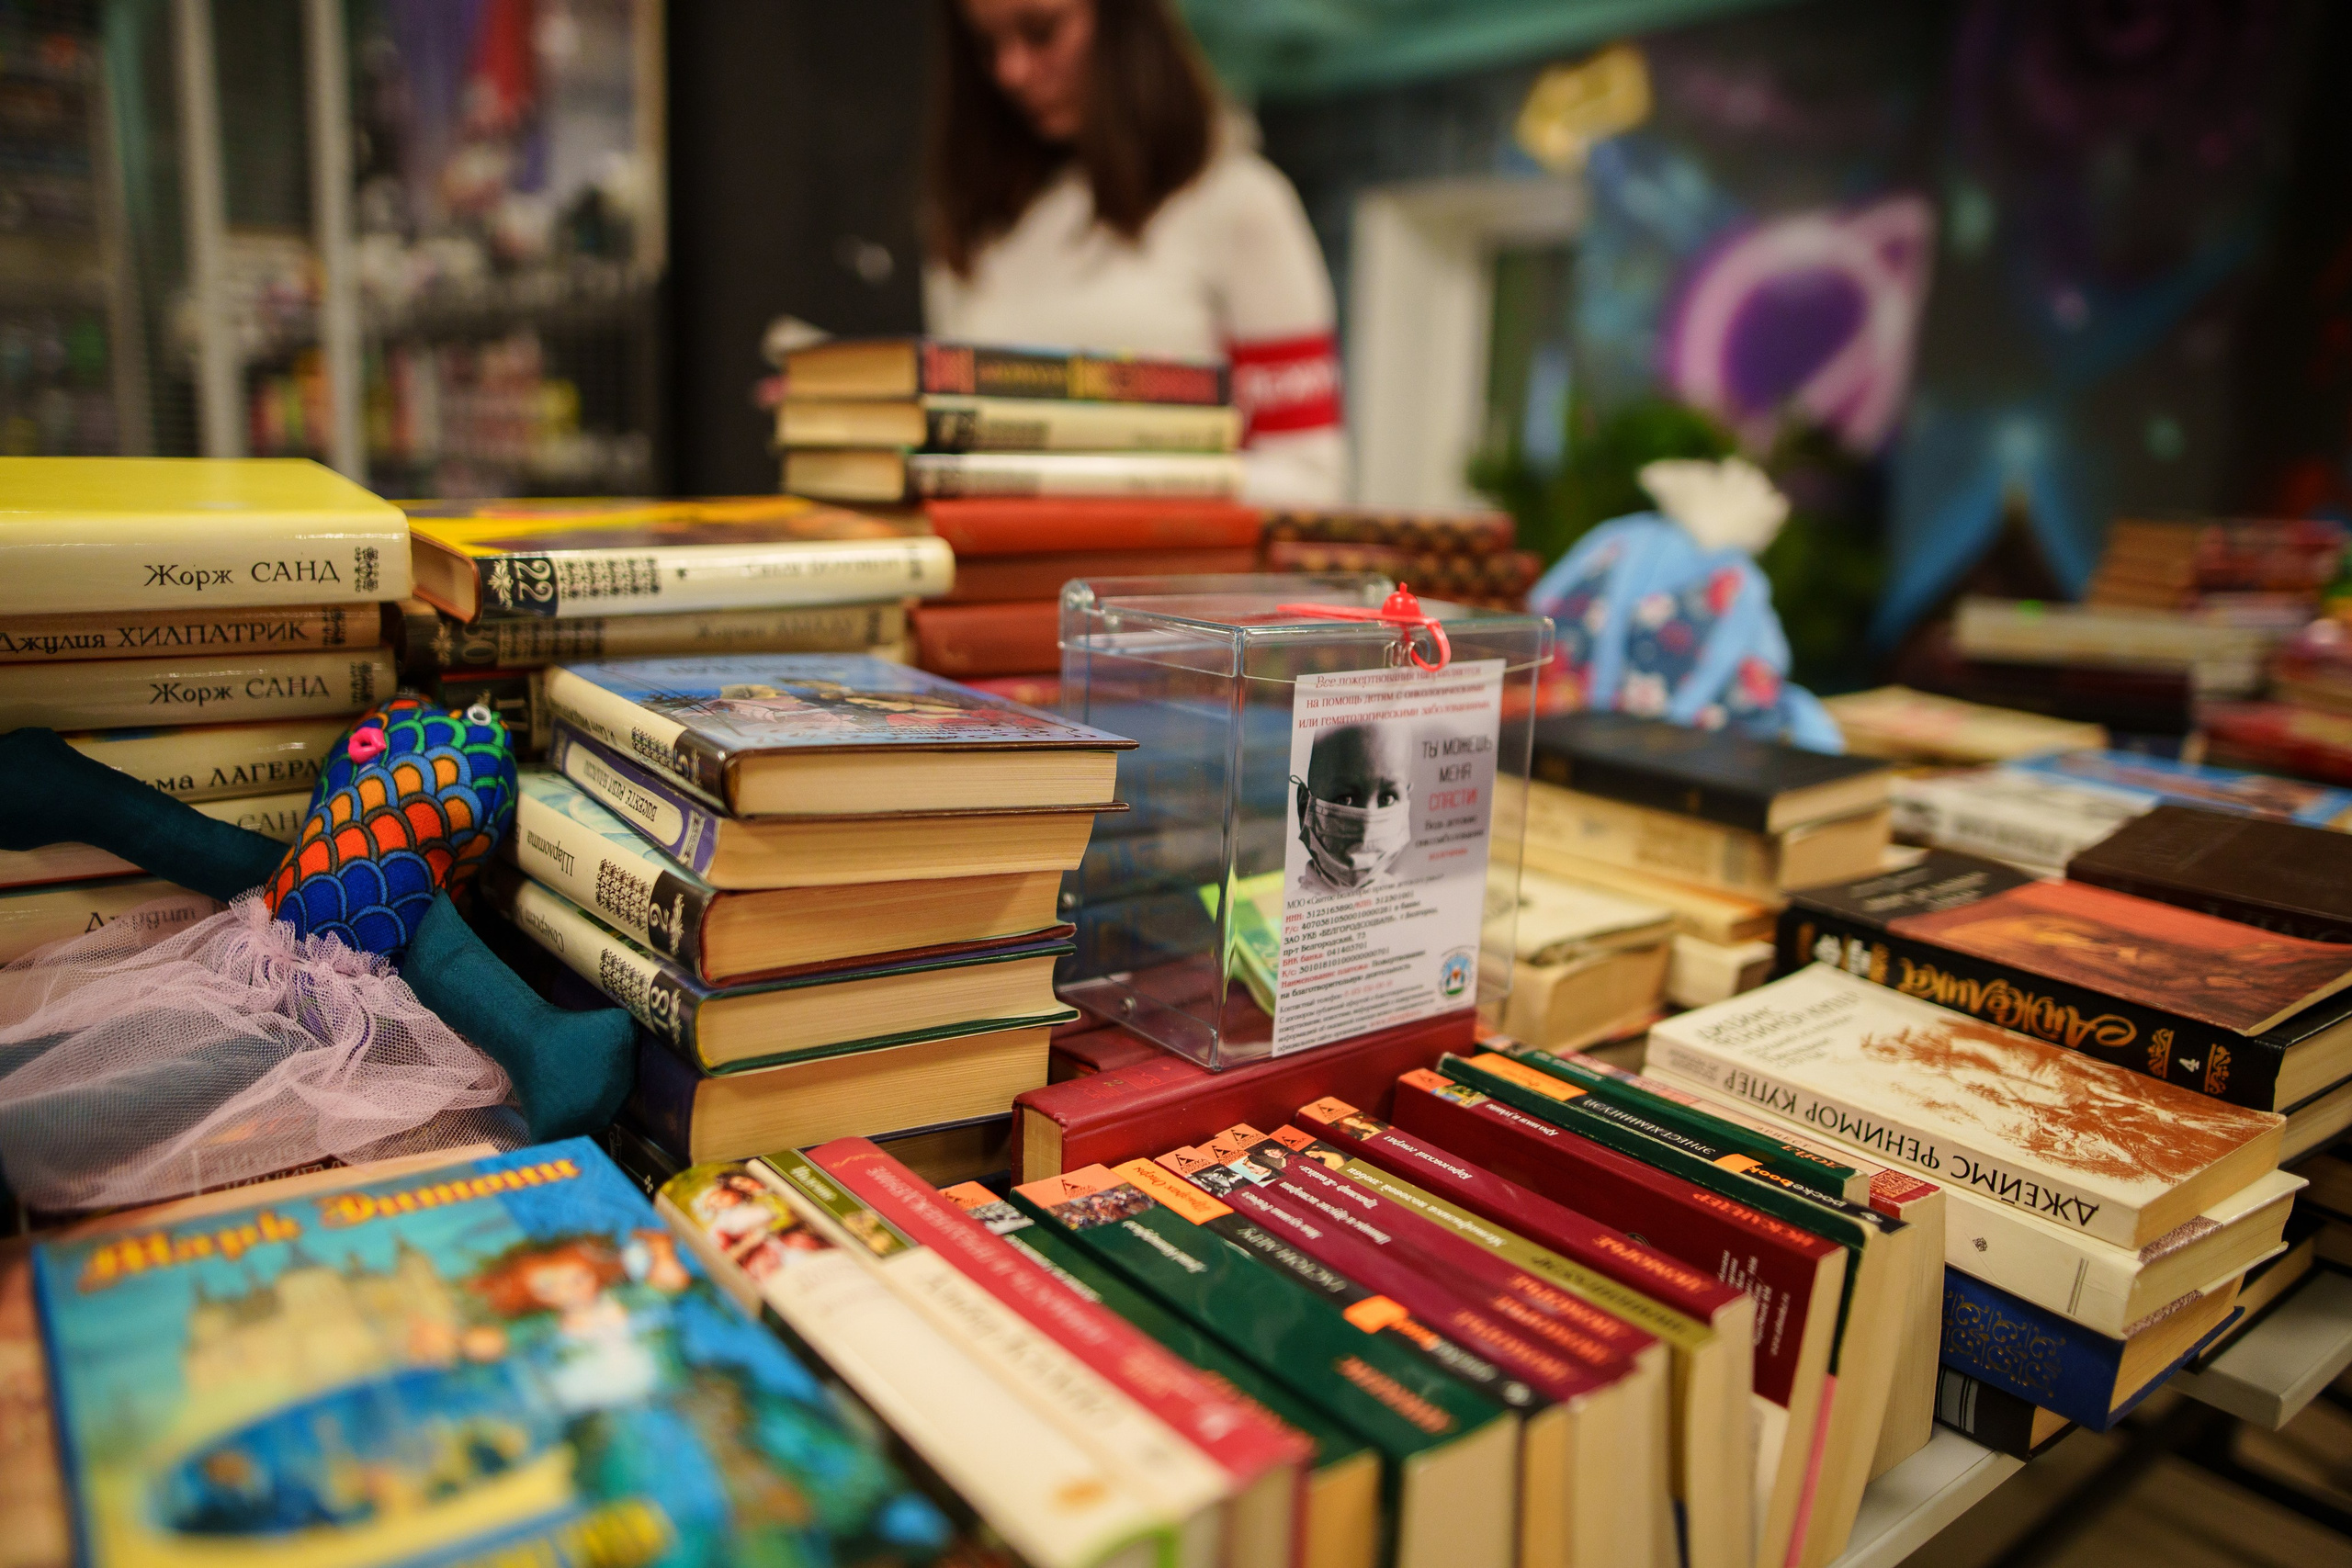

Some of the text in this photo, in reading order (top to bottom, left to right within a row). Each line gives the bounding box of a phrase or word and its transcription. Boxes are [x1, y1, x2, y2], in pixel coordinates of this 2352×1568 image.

[144, 560, 340, 591] Жорж САНД
[514, 558, 553, 602] 22
[0, 620, 309, 654] Джулия ХИЛПАТРИК
[150, 676, 331, 706] Жорж САНД
[1316, 674, 1336, 687] Все
[1338, 670, 1414, 689] пожертвования
[1306, 698, 1318, 708] на
[1322, 693, 1362, 708] помощь
[1363, 691, 1394, 704] детям
[1298, 717, 1317, 728] или
[1321, 706, 1419, 727] гематологическими
[1422, 733, 1493, 759] ТЫ МОЖЕШЬ
[1439, 761, 1472, 783] МЕНЯ
[624, 786, 658, 823] ВИСЕНТЕ
[237, 809, 300, 832] САН
[526, 830, 575, 877] Шарлотта
[650, 902, 671, 928] 2
[1286, 897, 1305, 909] МОО
[1285, 913, 1304, 922] ИНН:
[1283, 934, 1299, 944] ЗАО
[1302, 931, 1317, 941] УКБ
[1283, 946, 1298, 956] пр-т
[1283, 956, 1297, 966] БИК
[1280, 991, 1290, 999] на
[1292, 973, 1363, 998] благотворительную
[1281, 970, 1334, 988] Наименование
[650, 985, 671, 1033] 18
[1896, 958, 2137, 1048] Анжелика
[2178, 1057, 2200, 1073] 4
[1582, 1099, 1717, 1156] ЭРНЕСТ ХЕМИНГУЭЙ
[1384, 1135, 1474, 1180] Королевский генерал
[1724, 1068, 2100, 1227] ДЖЕЙМС ФЕНИМОР КУПЕР
[1781, 1145, 1846, 1168] ДОЙЛ
[1347, 1166, 1383, 1186] любви
[1749, 1166, 1847, 1208] pocketbook
[1133, 1166, 1211, 1213] Призрак Оперы
[1279, 1181, 1320, 1206] истории
[1382, 1182, 1430, 1209] половой
[1693, 1193, 1815, 1247] ИСКАНДЕР
[1237, 1226, 1348, 1293] ГАСТОН ЛЕРУ
